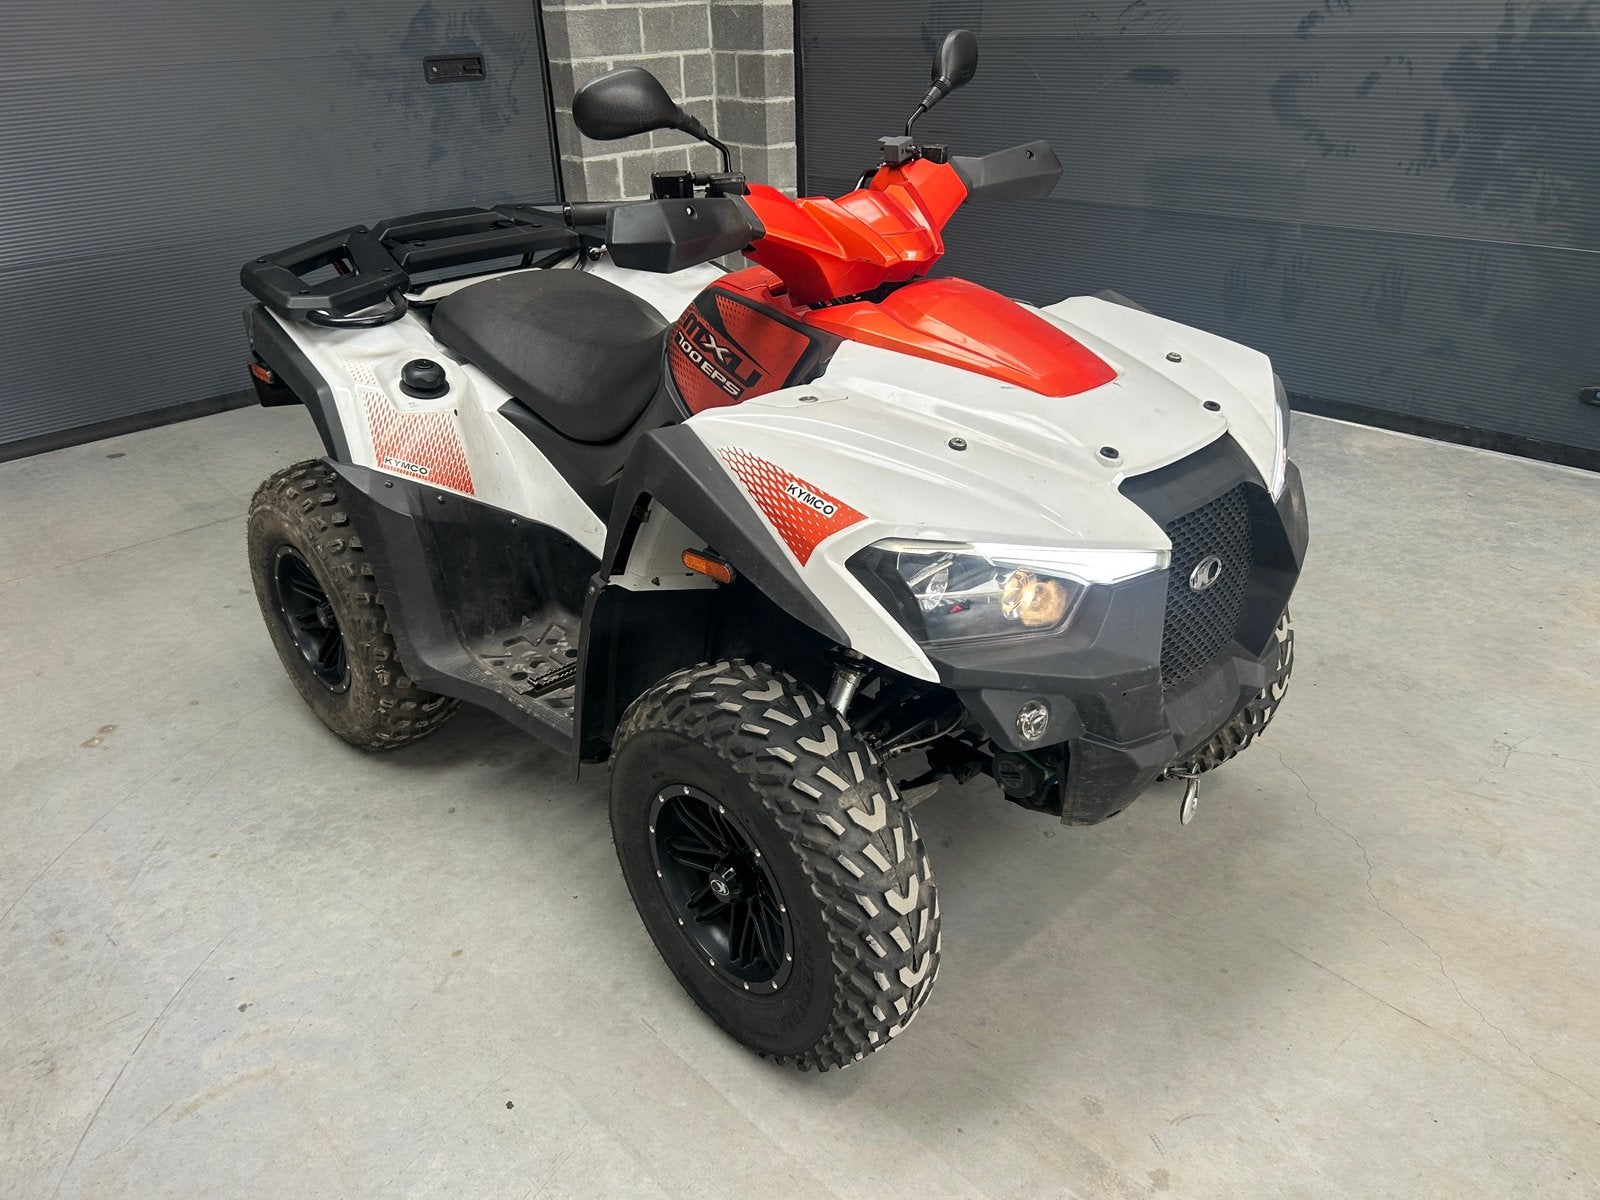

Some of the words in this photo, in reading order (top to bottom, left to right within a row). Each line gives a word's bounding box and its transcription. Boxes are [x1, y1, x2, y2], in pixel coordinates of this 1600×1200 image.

[678, 331, 703, 363] 700
[700, 360, 741, 396] EPS
[384, 457, 429, 475] KYMCO
[786, 484, 834, 515] KYMCO
